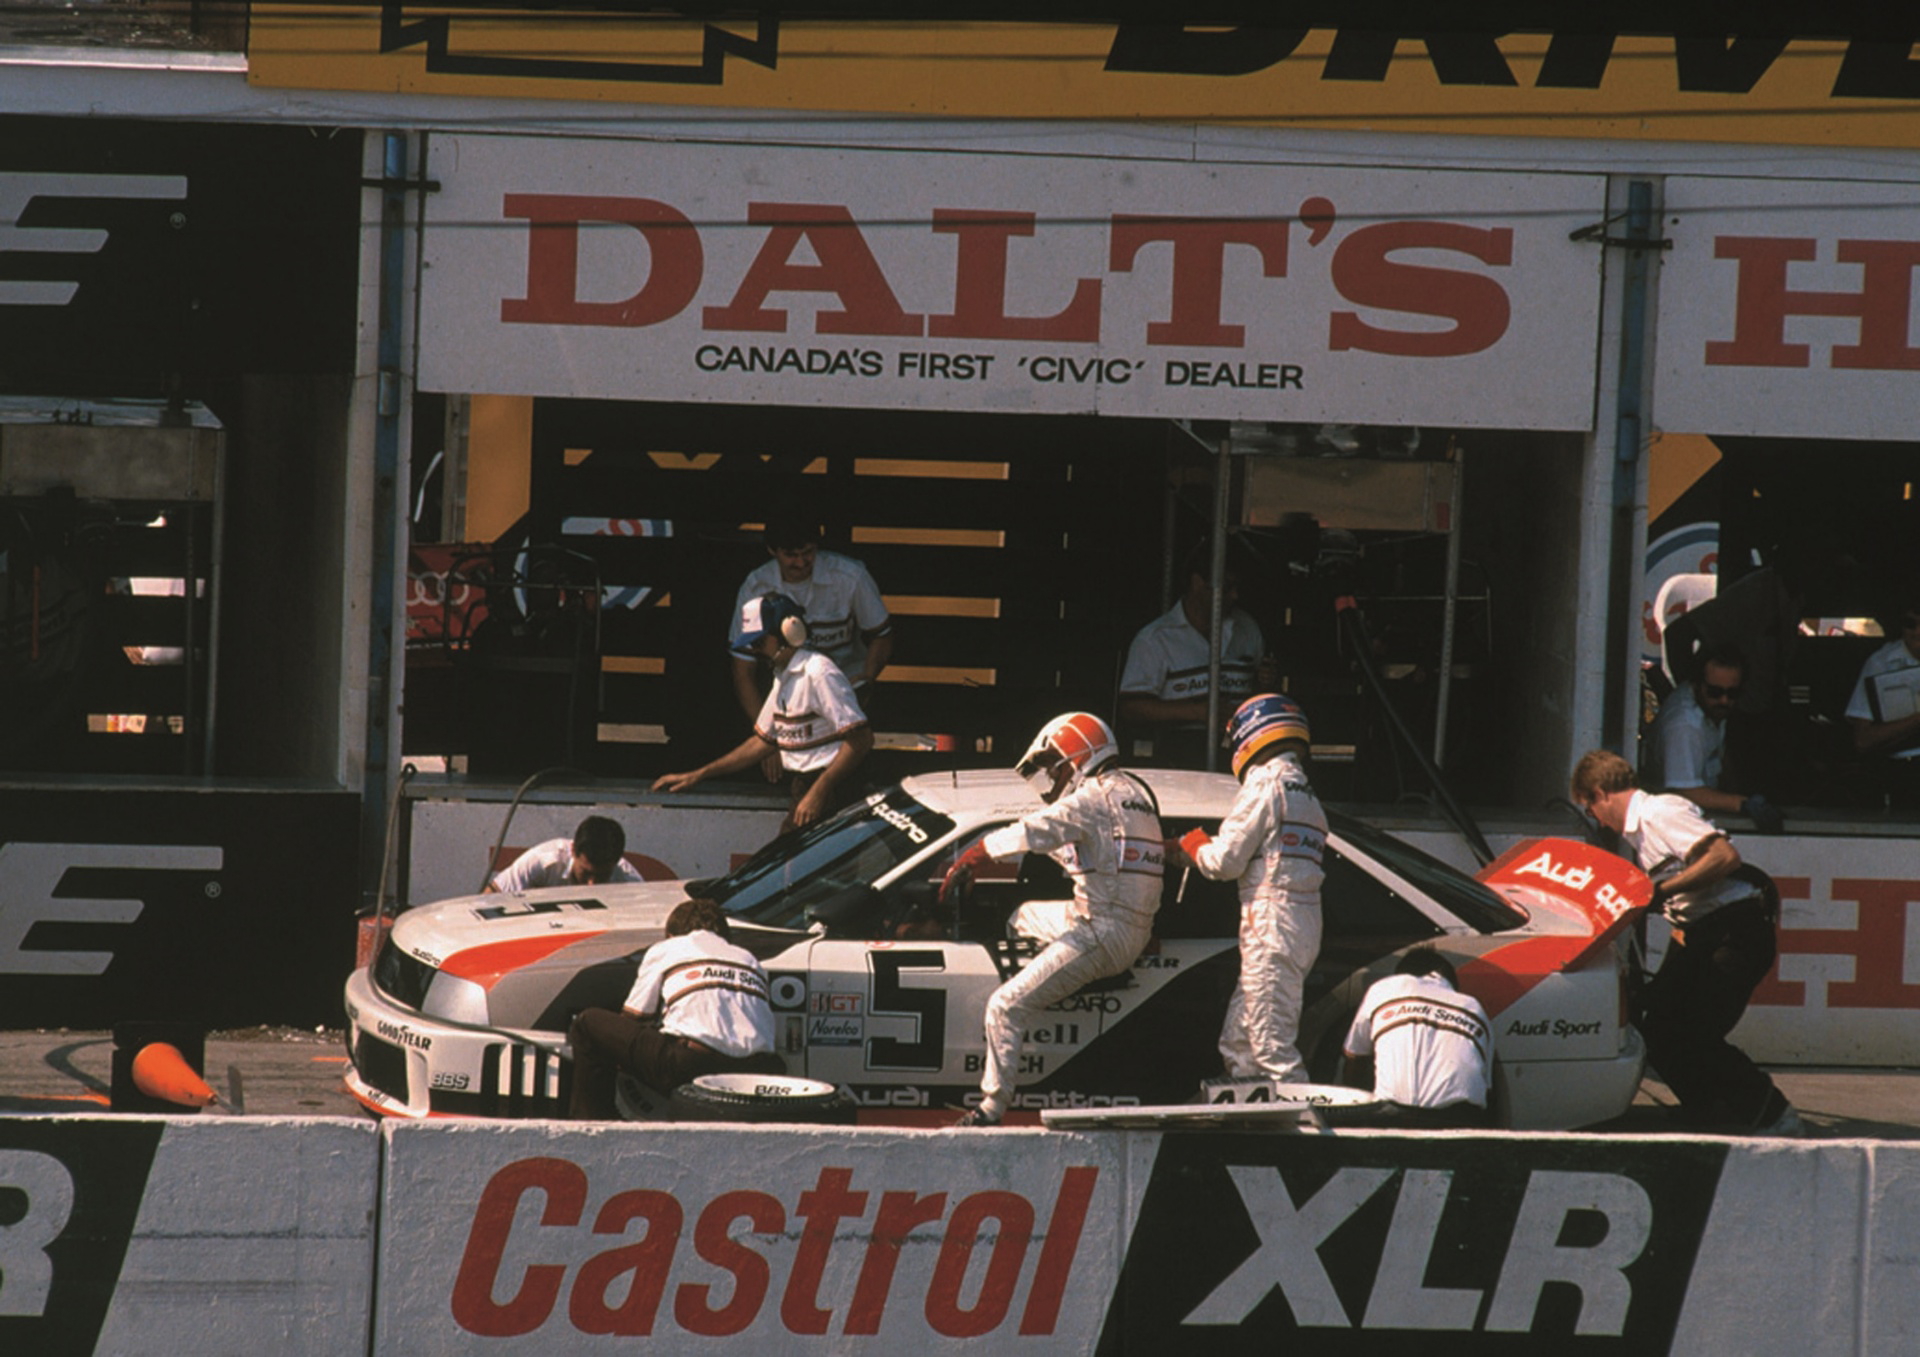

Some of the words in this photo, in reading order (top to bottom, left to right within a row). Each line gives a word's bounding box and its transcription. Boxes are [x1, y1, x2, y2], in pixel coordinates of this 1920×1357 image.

[500, 192, 1514, 358] DALT'S
[695, 344, 884, 377] CANADA'S
[898, 352, 995, 381] FIRST
[1164, 360, 1305, 390] DEALER
[1513, 852, 1595, 891] Audi
[702, 966, 736, 980] Audi
[810, 1014, 860, 1038] Norelco
[866, 949, 948, 1072] 5
[1397, 1003, 1432, 1017] Audi
[1432, 1008, 1476, 1034] Sport
[1505, 1020, 1551, 1036] Audi
[1552, 1020, 1602, 1039] Sport
[450, 1155, 1099, 1339] Castrol
[1180, 1164, 1654, 1337] XLR
